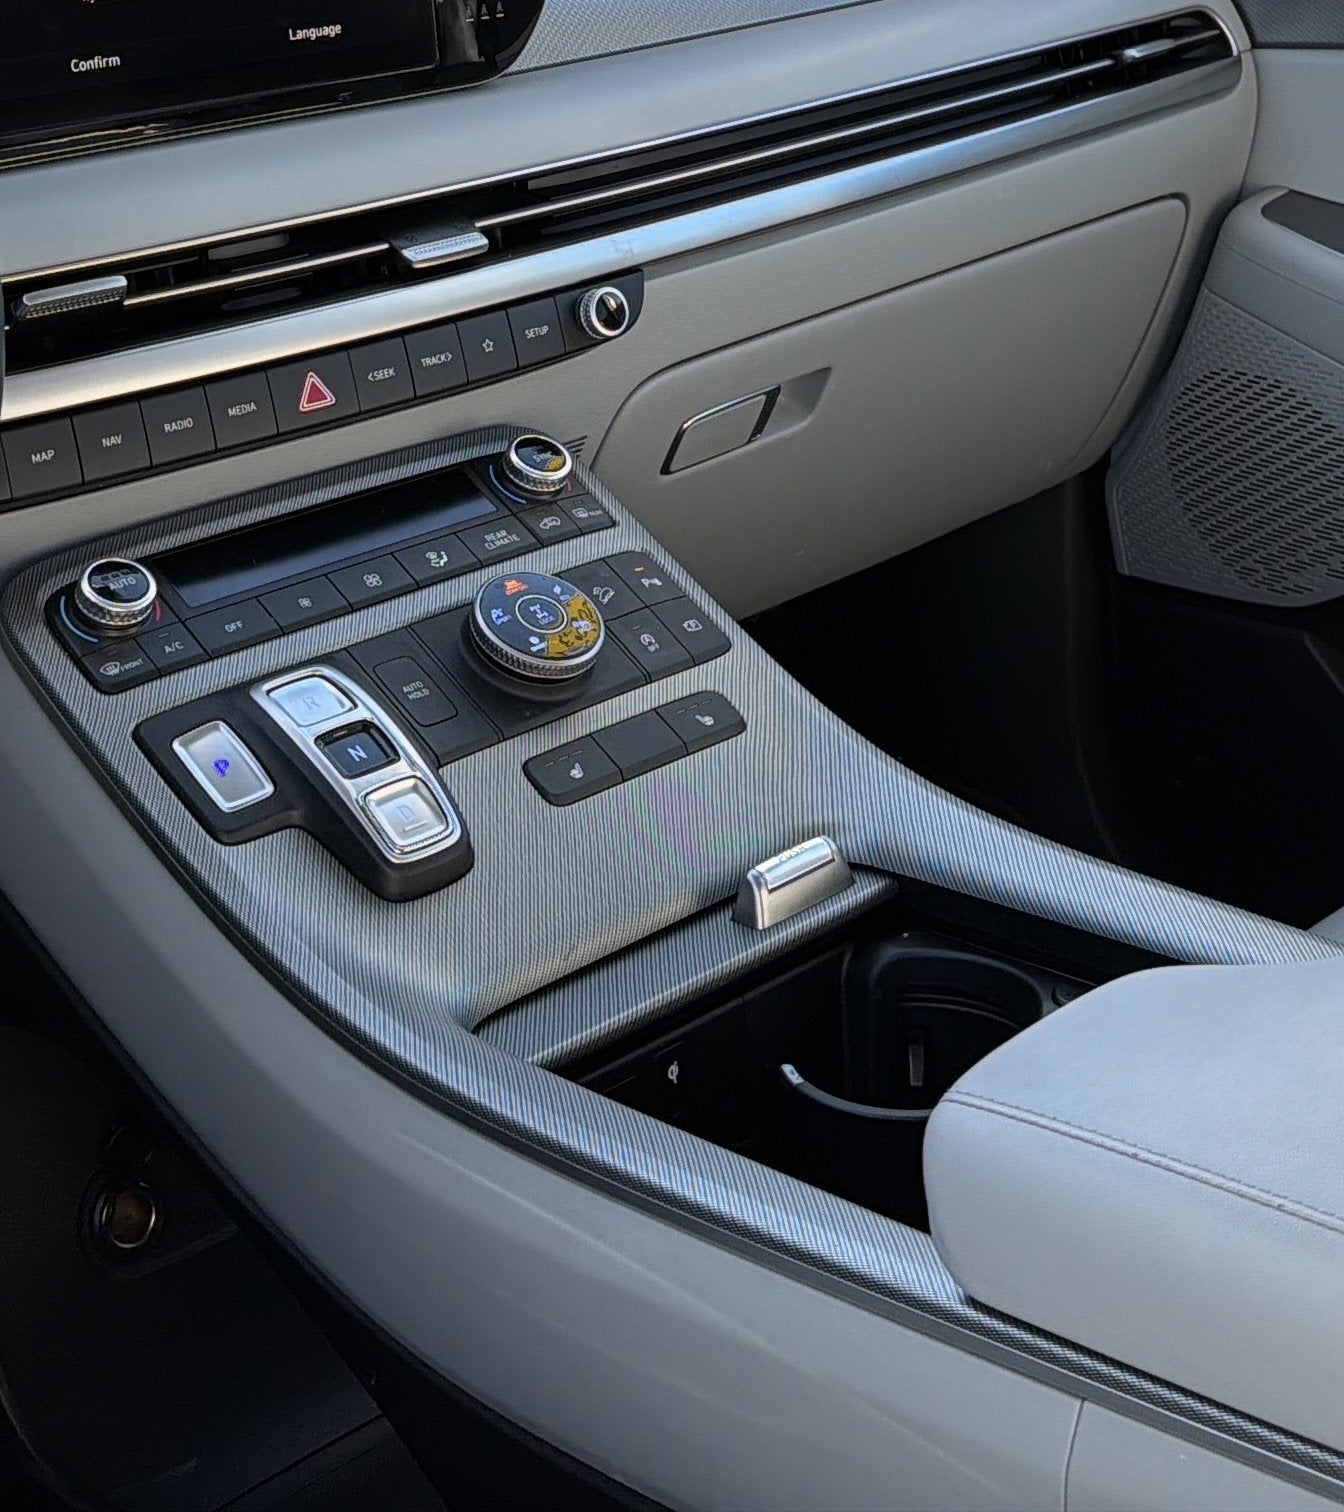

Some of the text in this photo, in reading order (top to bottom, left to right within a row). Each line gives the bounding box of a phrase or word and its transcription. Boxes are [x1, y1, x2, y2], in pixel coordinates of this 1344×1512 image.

[288, 23, 342, 41] Language
[70, 54, 121, 73] Confirm
[524, 325, 550, 340] SETUP
[227, 401, 258, 417] MEDIA
[163, 417, 194, 433] RADIO
[102, 434, 122, 448] NAV
[31, 449, 55, 464] MAP
[483, 529, 508, 542] REAR
[483, 533, 521, 550] CLIMATE
[109, 576, 137, 591] AUTO
[225, 620, 244, 633] OFF
[164, 641, 185, 654] A/C
[119, 658, 144, 672] FRONT
[402, 680, 424, 693] AUTO
[407, 688, 430, 700] HOLD
[305, 694, 320, 711] R
[346, 743, 369, 762] N
[396, 804, 414, 822] D
